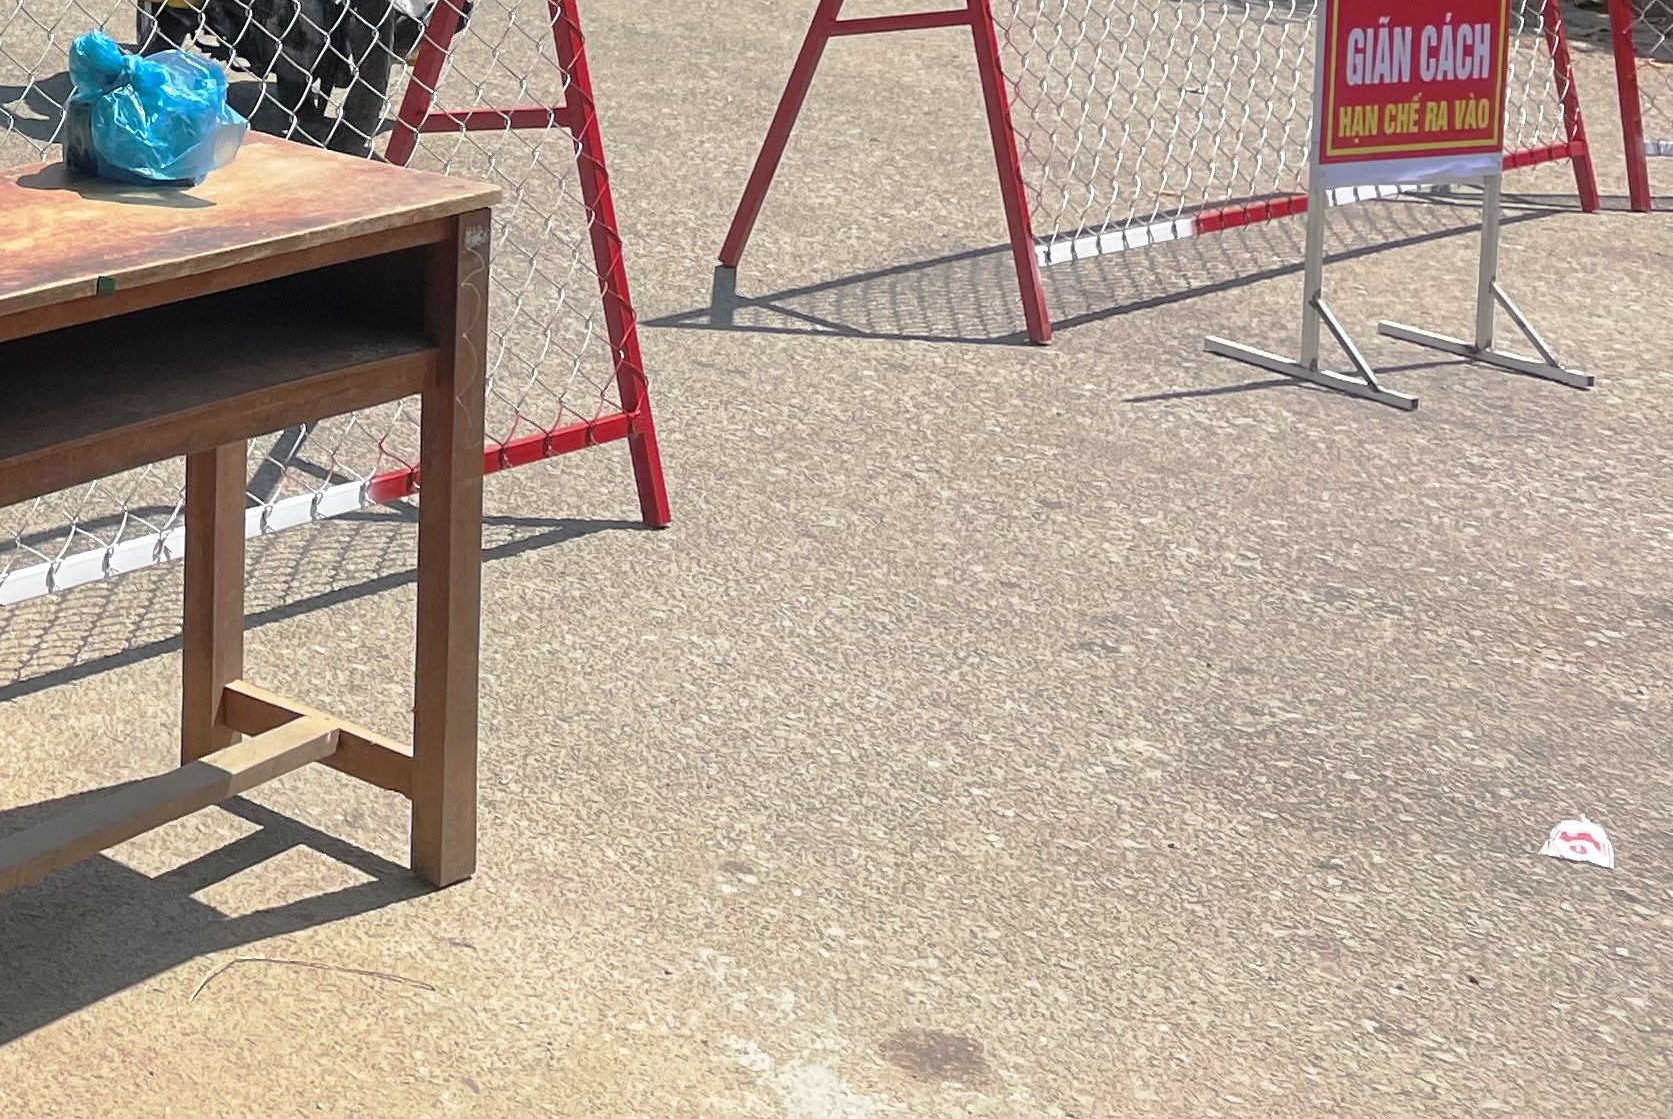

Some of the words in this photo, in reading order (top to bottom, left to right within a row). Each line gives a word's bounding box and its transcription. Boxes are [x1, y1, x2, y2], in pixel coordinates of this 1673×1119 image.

[1346, 15, 1412, 86] GIÃN
[1419, 12, 1492, 82] CÁCH
[1338, 103, 1379, 143] HẠN
[1384, 92, 1420, 135] CHẾ
[1426, 102, 1448, 131] RA
[1454, 92, 1490, 131] VÀO
